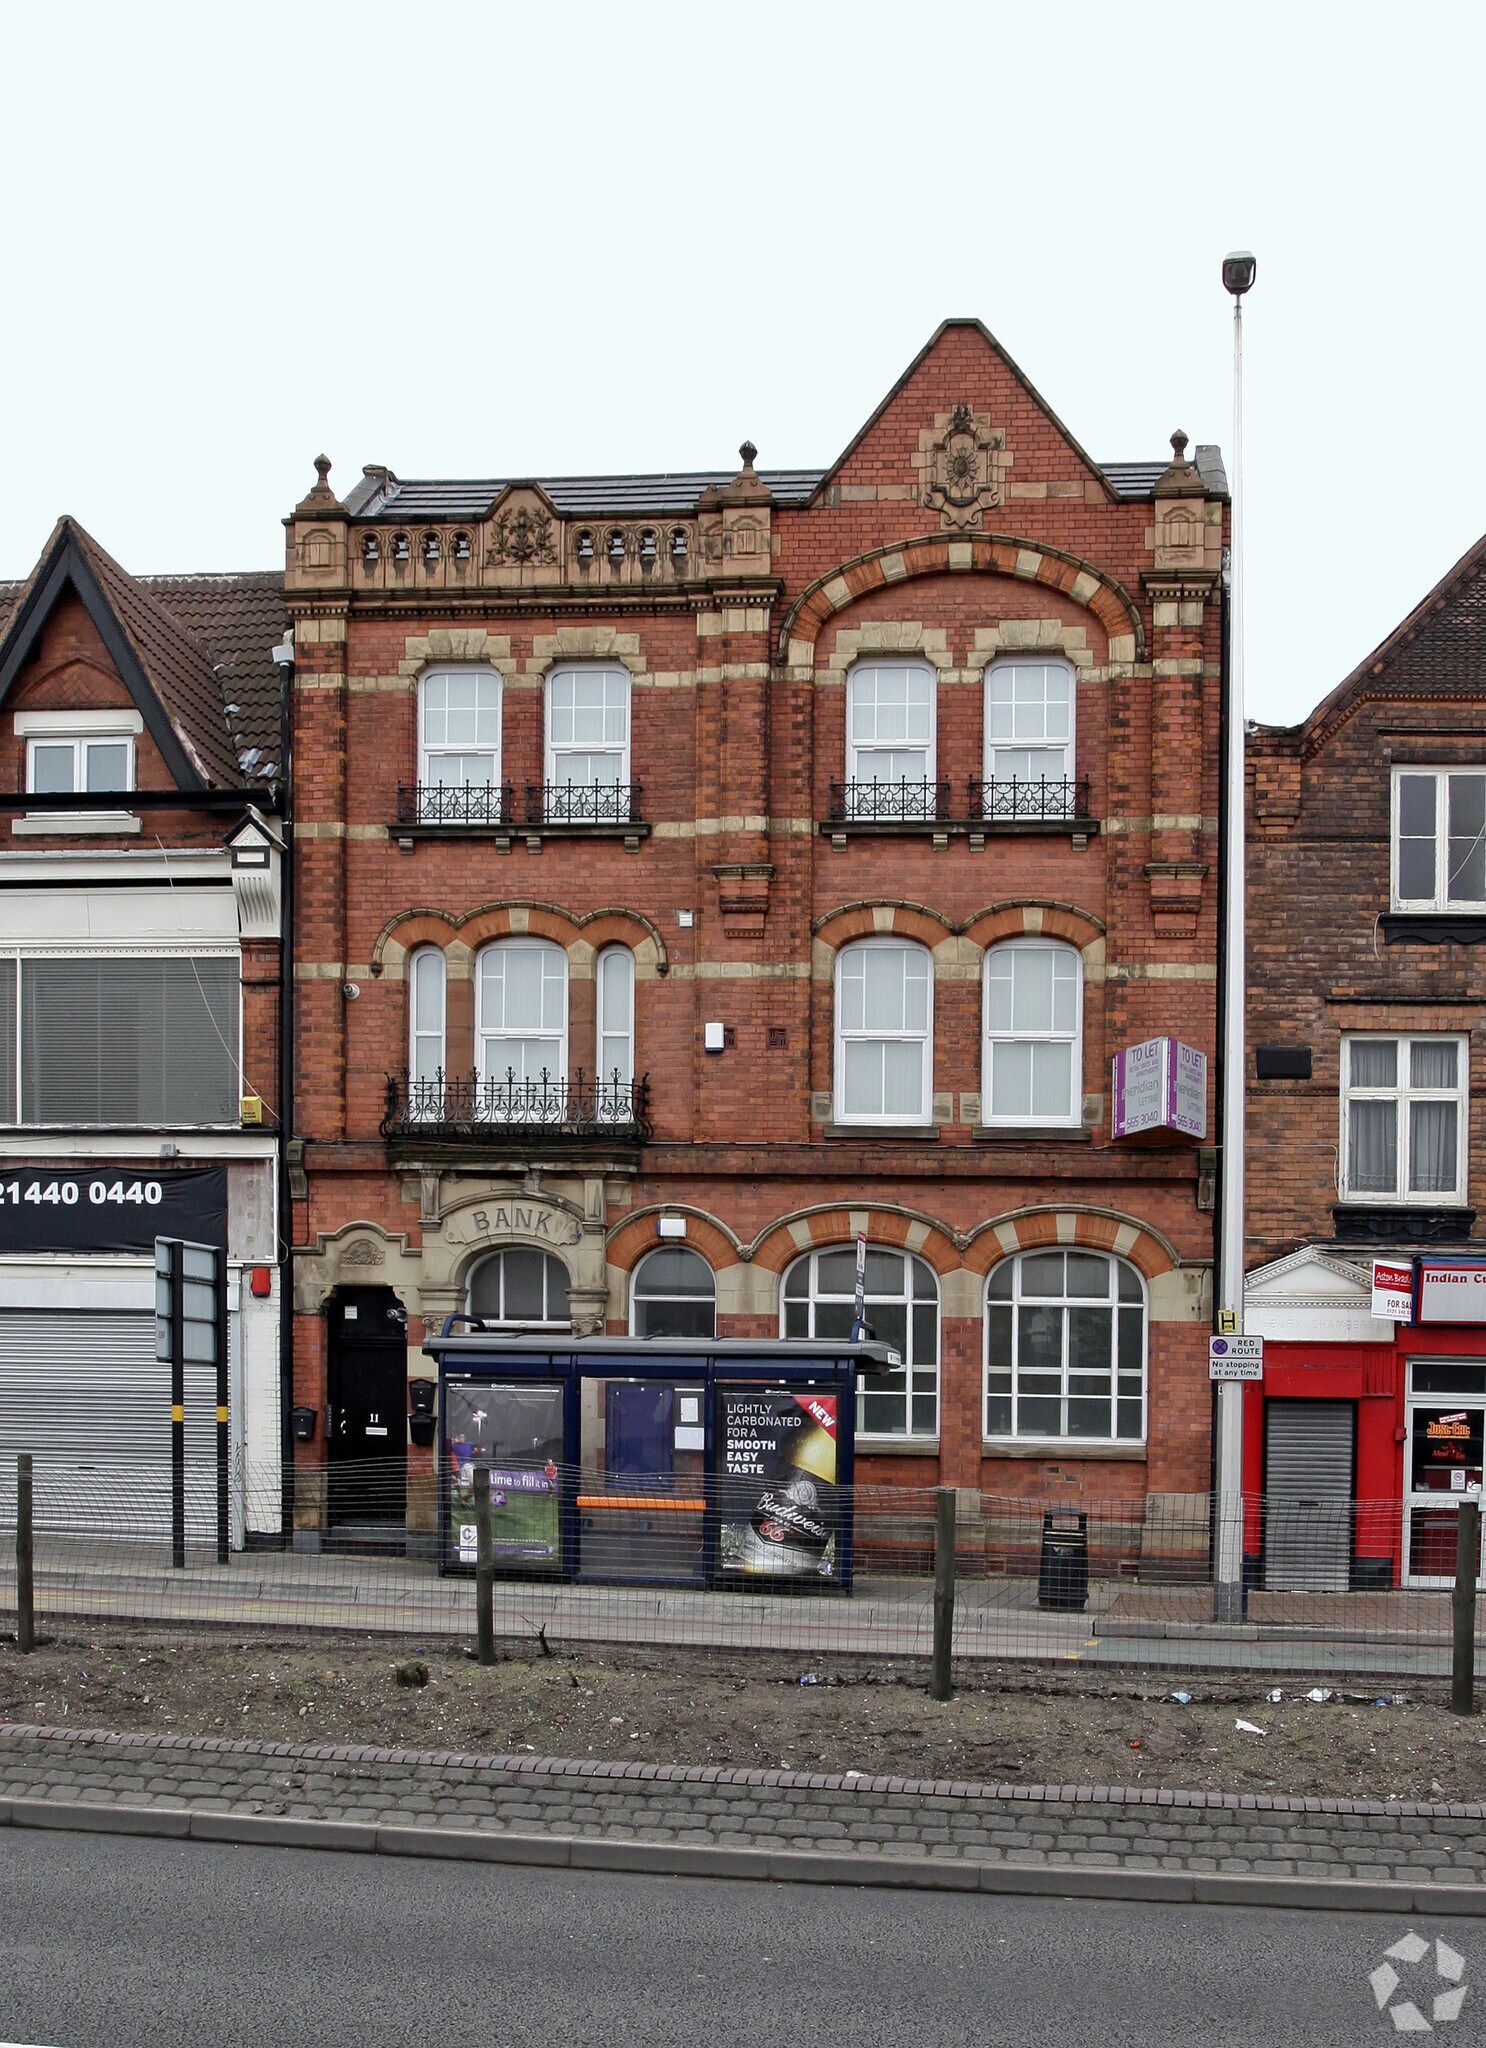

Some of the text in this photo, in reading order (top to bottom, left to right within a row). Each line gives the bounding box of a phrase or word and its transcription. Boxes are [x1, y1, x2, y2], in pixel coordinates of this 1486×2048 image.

[1132, 1041, 1159, 1063] TO LET
[1182, 1046, 1202, 1068] TO LET
[0, 1182, 162, 1204] 1440 0440
[472, 1208, 553, 1234] BANK
[1426, 1273, 1467, 1283] Indian
[1387, 1299, 1400, 1308] FOR
[1221, 1312, 1235, 1330] H
[1226, 1361, 1259, 1369] stopping
[727, 1404, 772, 1414] LIGHTLY
[808, 1400, 835, 1428] NEW
[727, 1416, 801, 1426] CARBONATED
[727, 1428, 758, 1438] FOR A
[726, 1440, 776, 1450] SMOOTH
[726, 1452, 758, 1462] EASY
[727, 1464, 764, 1474] TASTE
[490, 1473, 512, 1486] time
[522, 1475, 534, 1487] fill
[535, 1480, 540, 1488] it
